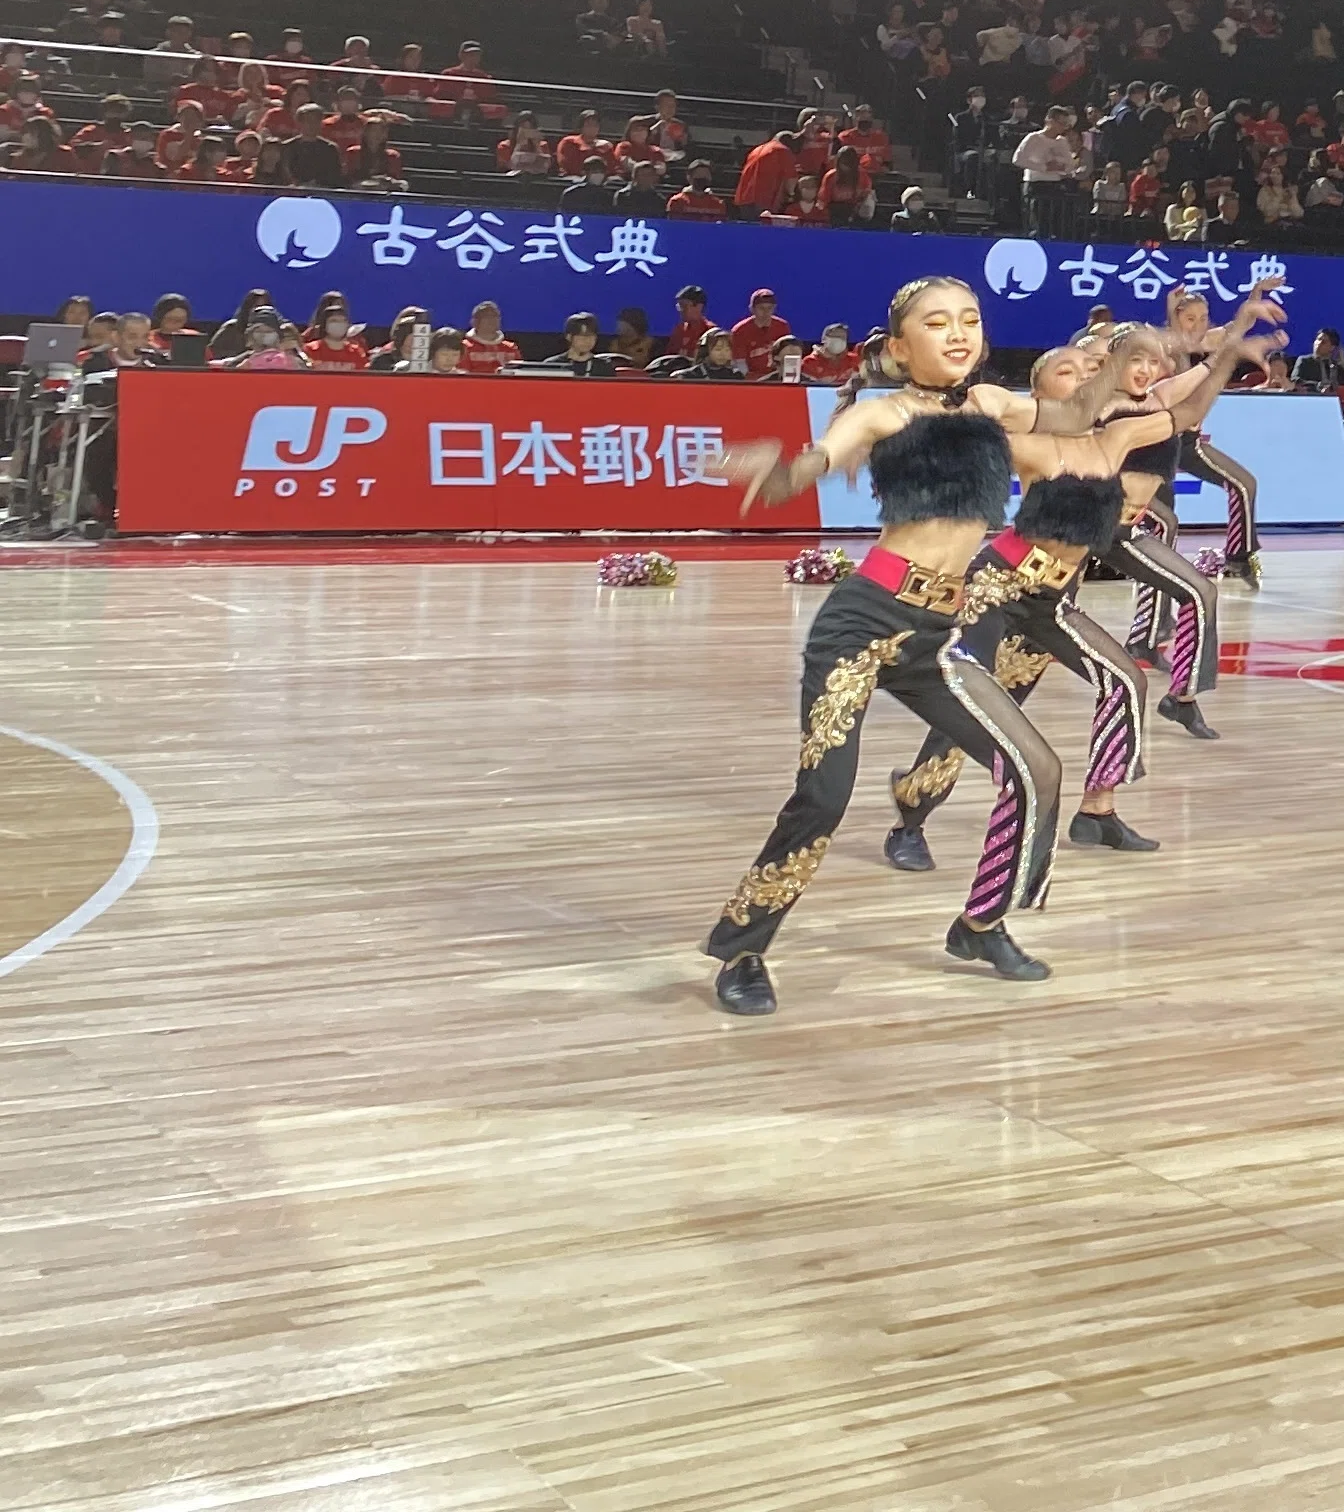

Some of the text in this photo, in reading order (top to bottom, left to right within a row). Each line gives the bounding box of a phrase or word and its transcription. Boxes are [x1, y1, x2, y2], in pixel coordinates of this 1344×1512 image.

[357, 205, 668, 277] 古谷式典
[1059, 245, 1294, 305] 古谷式典
[241, 406, 387, 471] JP
[429, 421, 728, 487] 日本郵便
[234, 478, 376, 497] POST
